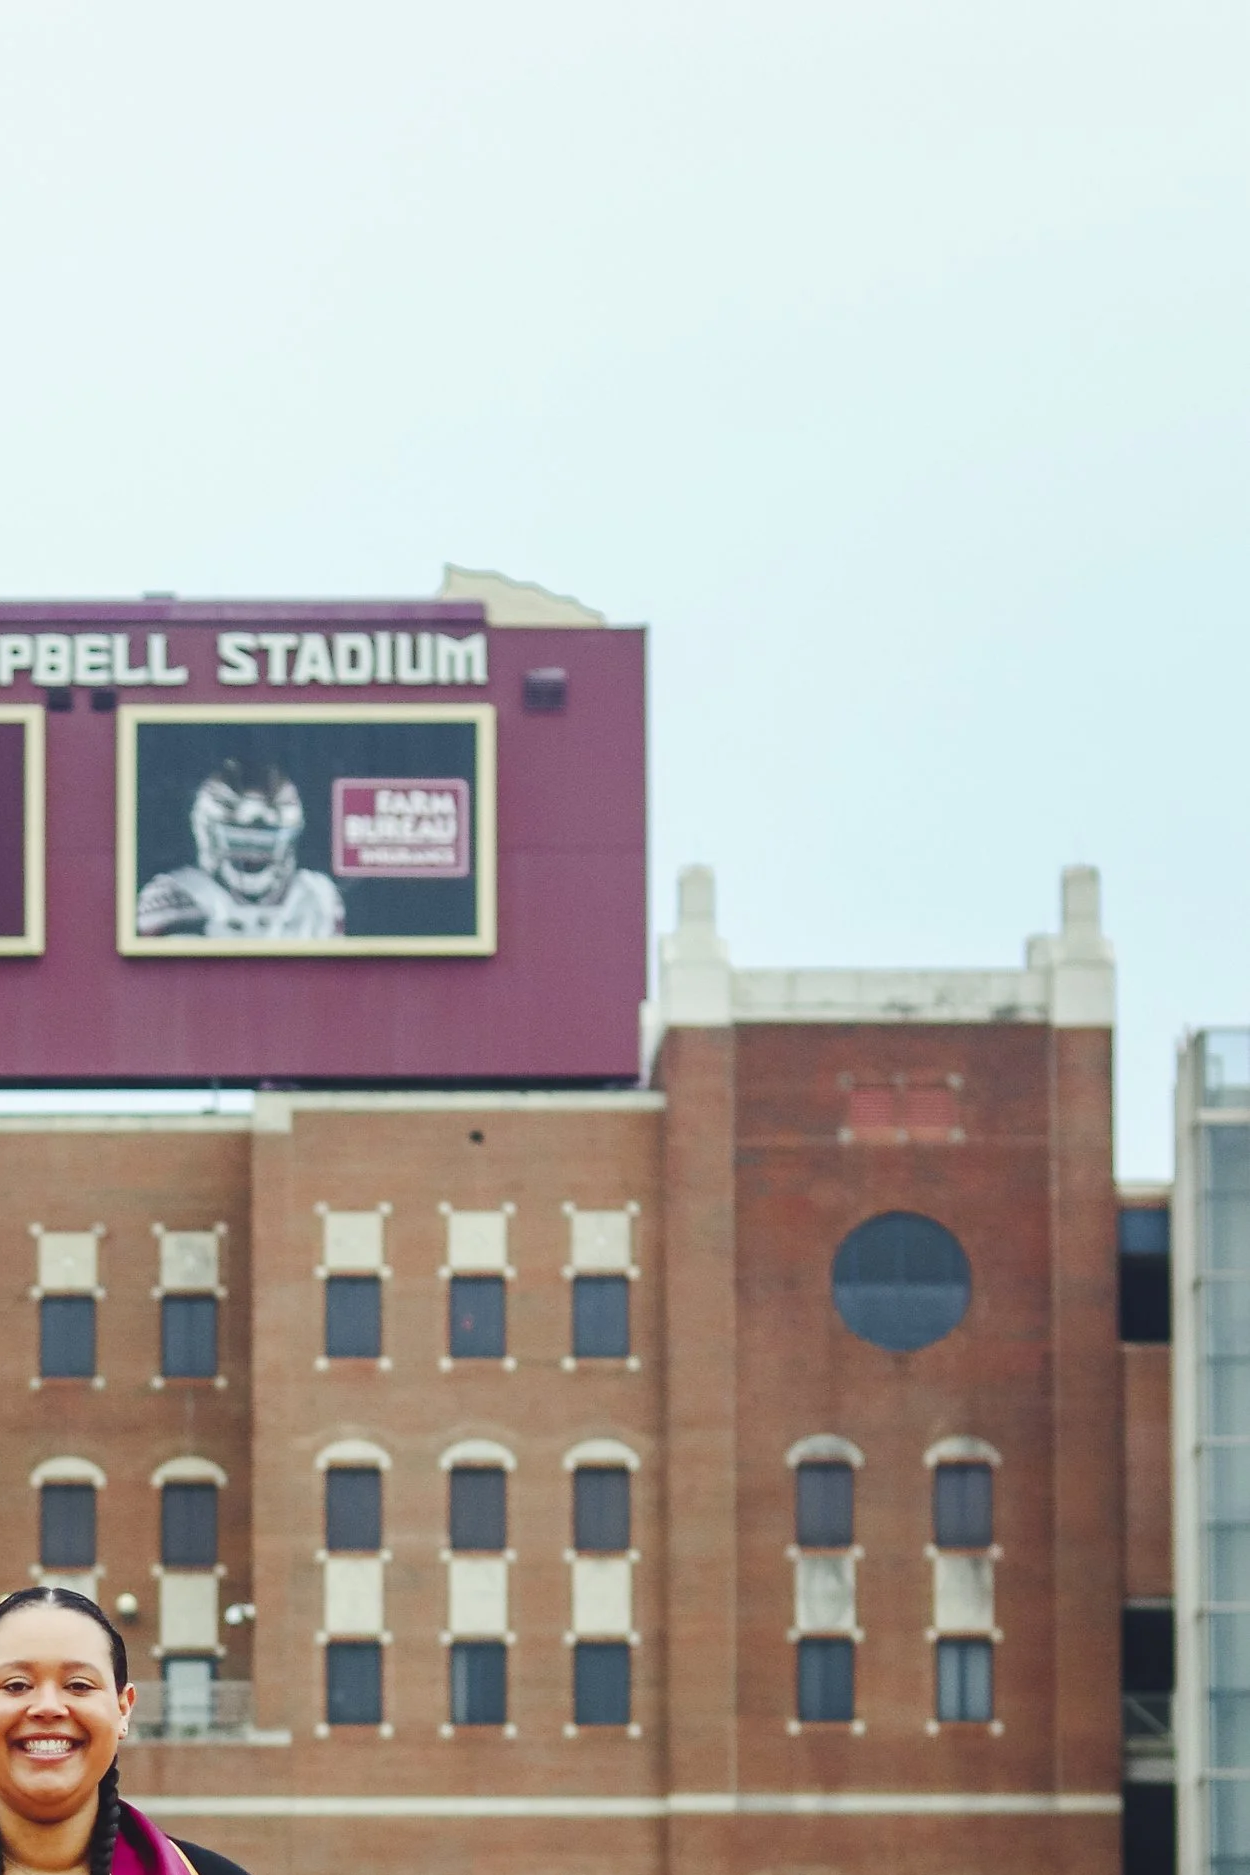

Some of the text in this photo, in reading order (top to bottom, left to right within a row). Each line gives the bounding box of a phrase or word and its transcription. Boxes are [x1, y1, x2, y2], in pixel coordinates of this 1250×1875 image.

[216, 631, 488, 686] STADIUM
[375, 790, 456, 815] FARM
[345, 814, 457, 845] BUREAU
